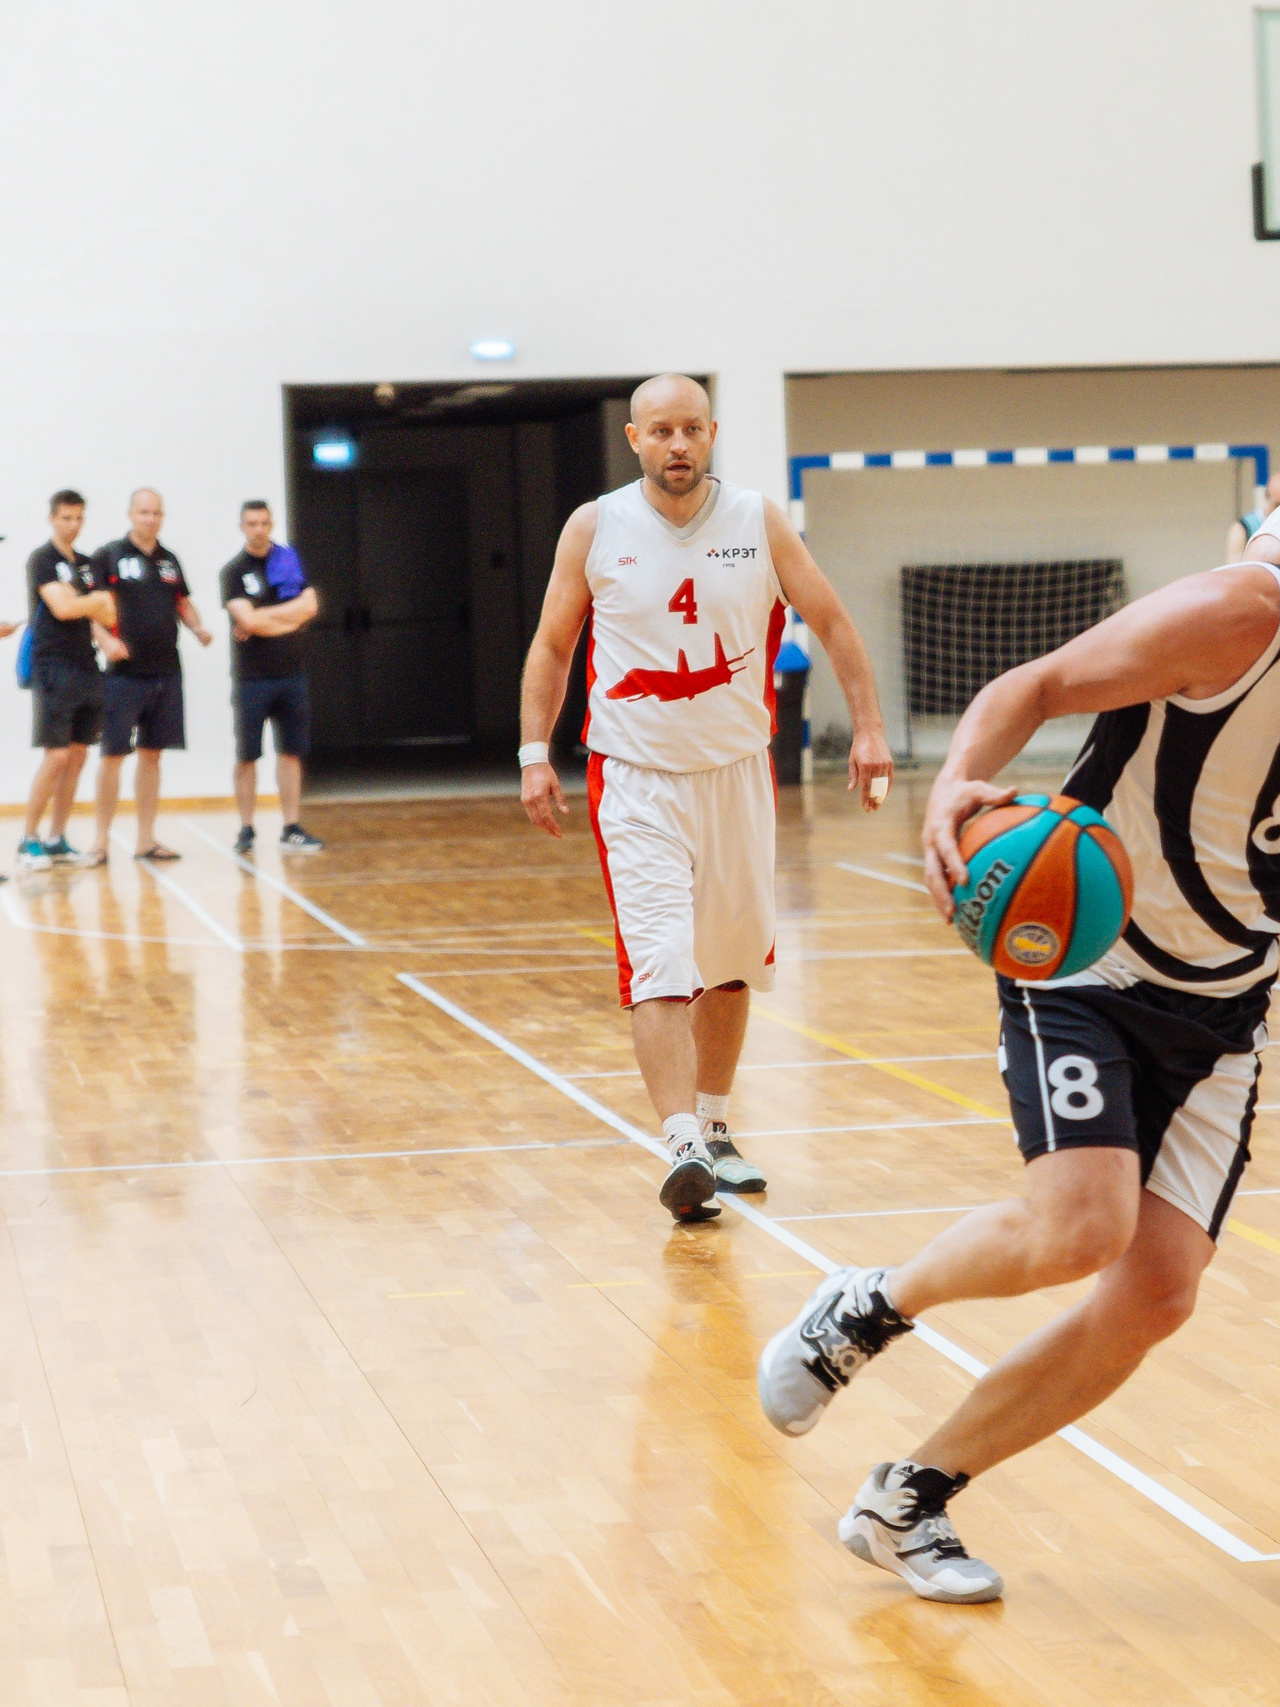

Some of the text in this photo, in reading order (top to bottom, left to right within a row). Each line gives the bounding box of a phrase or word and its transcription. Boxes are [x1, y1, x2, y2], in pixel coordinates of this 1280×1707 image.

[618, 556, 638, 566] STK
[722, 548, 757, 559] КРЭТ
[668, 578, 697, 624] 4
[1047, 1054, 1105, 1121] 8
